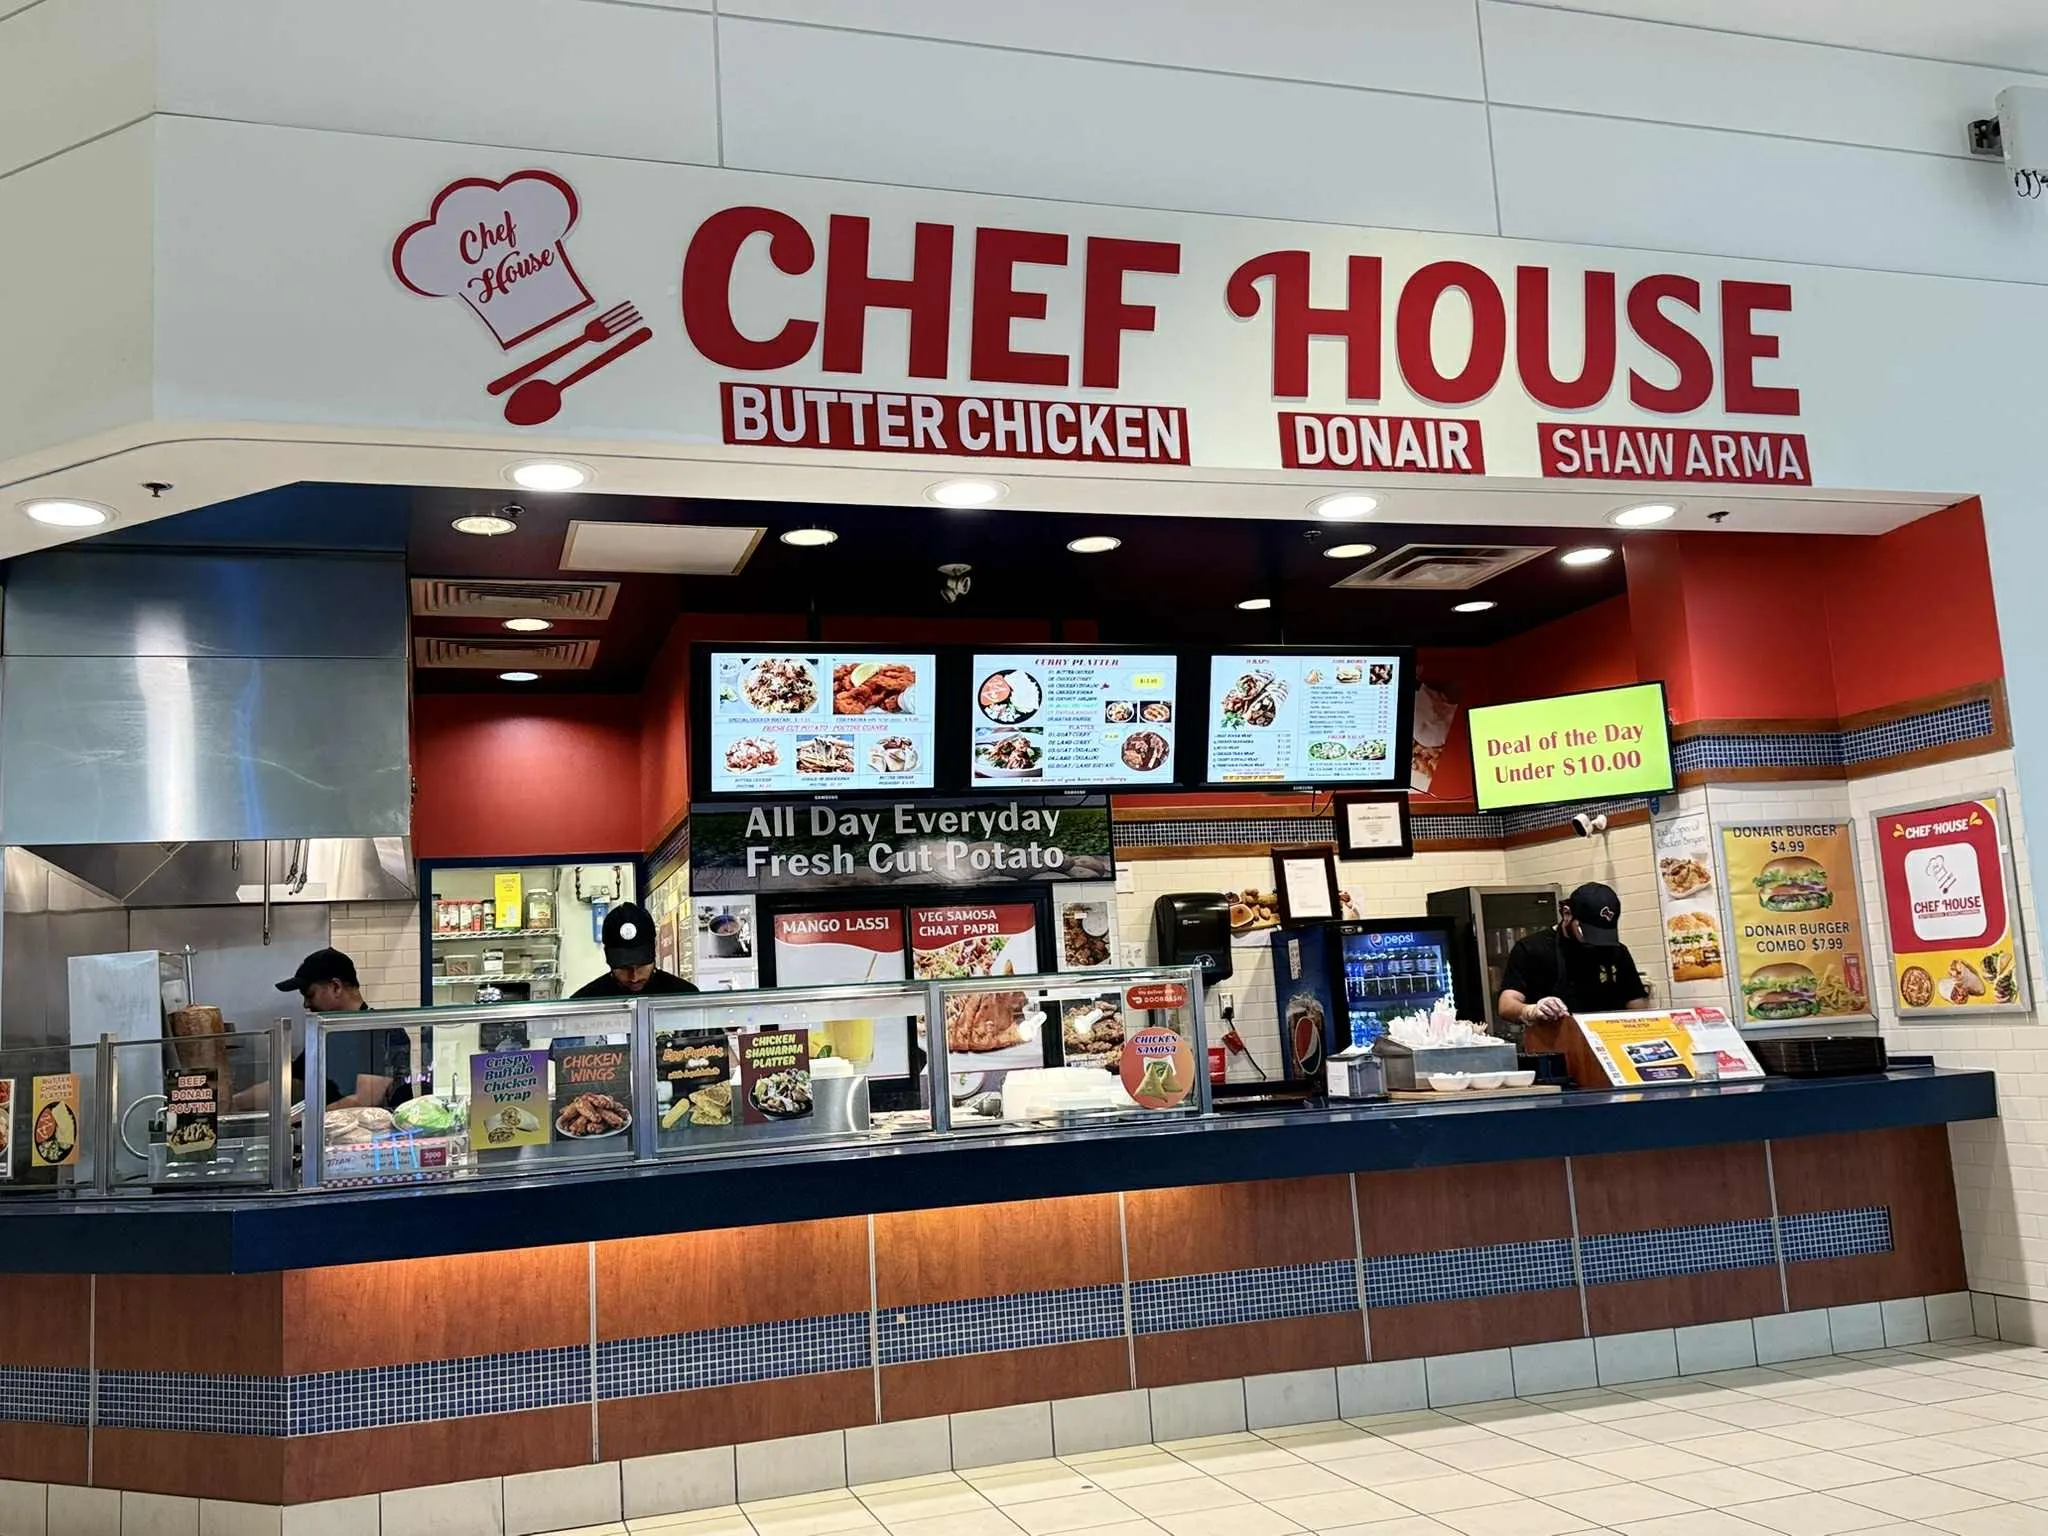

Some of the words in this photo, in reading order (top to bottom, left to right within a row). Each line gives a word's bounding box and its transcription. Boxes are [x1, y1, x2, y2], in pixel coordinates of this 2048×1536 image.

[459, 210, 517, 264] Chef
[467, 248, 554, 303] House
[681, 206, 1181, 389] CHEF
[1226, 249, 1801, 416] HOUSE
[732, 385, 948, 449] BUTTER
[957, 397, 1181, 459] CHICKEN
[1295, 415, 1472, 470] DONAIR
[1487, 735, 1531, 757] Deal
[1538, 731, 1558, 750] of
[1564, 728, 1597, 748] the
[1604, 723, 1644, 743] Day
[1495, 763, 1555, 784] Under
[1563, 750, 1642, 776] $10.00
[745, 806, 795, 838] All
[810, 805, 880, 842] Day
[894, 801, 1061, 839] Everyday
[1905, 824, 1932, 839] CHEF
[1932, 818, 1968, 835] HOUSE
[1733, 825, 1783, 839] DONAIR
[1786, 824, 1837, 838] BURGER
[1770, 840, 1805, 854] $4.99
[746, 844, 855, 879] Fresh
[868, 842, 933, 874] Cut
[946, 840, 1064, 872] Potato
[1914, 900, 1940, 914] CHEF
[1941, 896, 1982, 911] HOUSE
[918, 910, 943, 923] VEG
[947, 909, 997, 922] SAMOSA
[783, 919, 840, 935] MANGO
[846, 917, 889, 932] LASSI
[919, 924, 959, 937] CHAAT
[963, 922, 1000, 935] PAPRI
[1744, 922, 1796, 938] DONAIR
[1798, 921, 1850, 936] BURGER
[1384, 932, 1415, 947] pepsi
[1756, 939, 1806, 954] COMBO
[1811, 937, 1843, 952] $7.99
[752, 1033, 796, 1047] CHICKEN
[1135, 1035, 1178, 1044] CHICKEN
[744, 1044, 804, 1059] SHAWARMA
[1136, 1045, 1177, 1055] SAMOSA
[486, 1054, 531, 1069] Crispy
[563, 1052, 624, 1069] CHICKEN
[752, 1056, 796, 1069] PLATTER
[485, 1063, 534, 1081] Buffalo
[569, 1067, 617, 1084] WINGS
[40, 1084, 72, 1092] CHICKEN
[178, 1075, 207, 1087] BEEF
[484, 1077, 537, 1093] Chicken
[171, 1088, 213, 1101] DONAIR
[492, 1090, 531, 1103] Wrap
[168, 1101, 216, 1114] POUTINE
